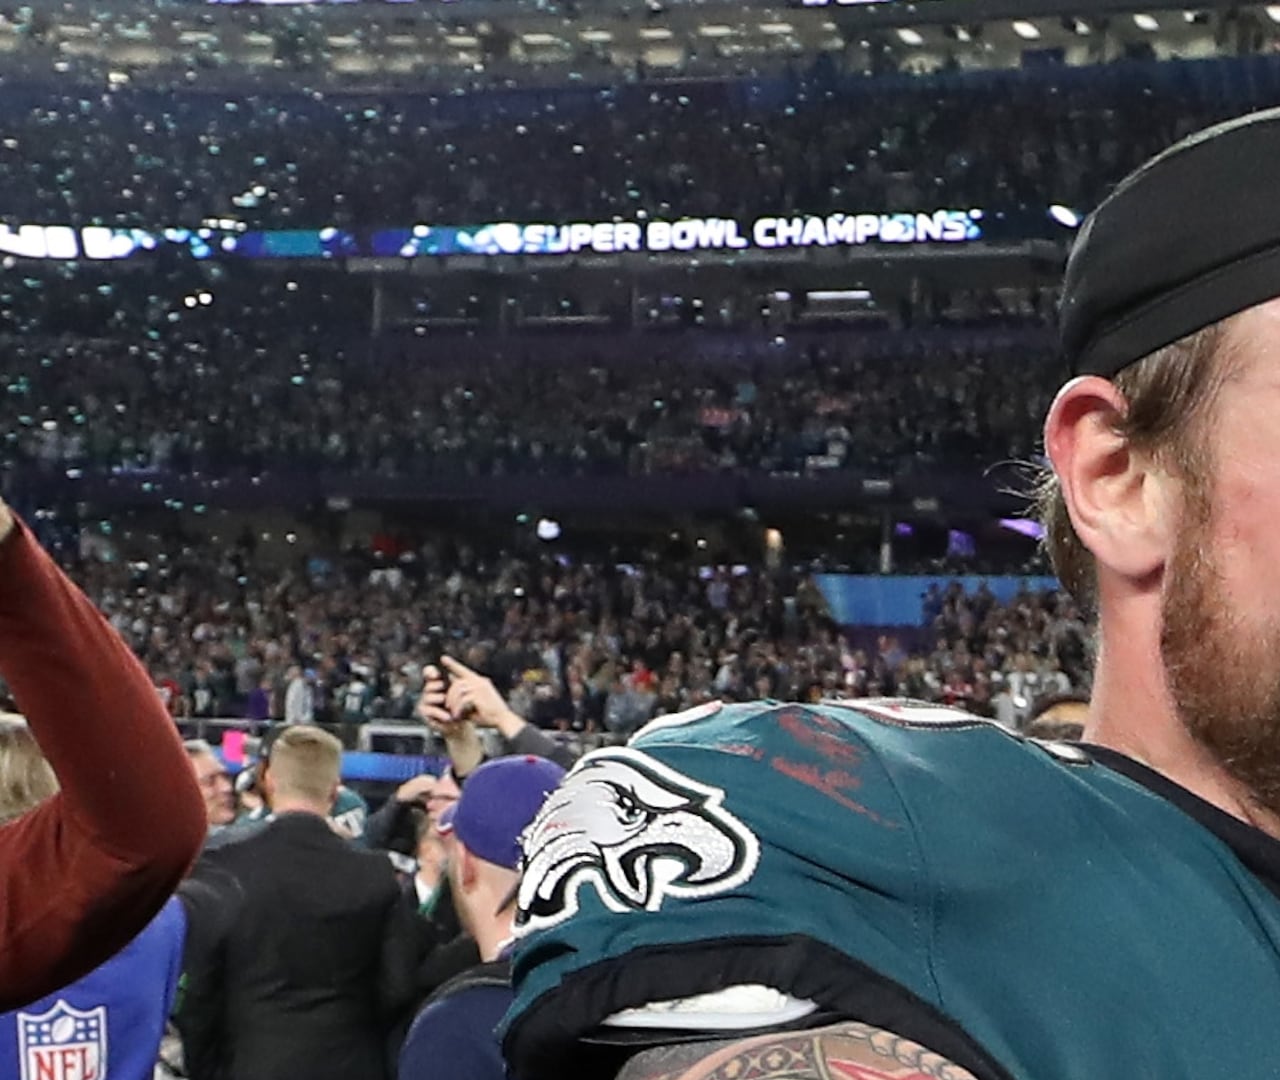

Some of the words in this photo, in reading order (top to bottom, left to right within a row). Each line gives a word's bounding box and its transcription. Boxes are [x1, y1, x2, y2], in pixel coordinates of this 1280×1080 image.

[523, 221, 642, 253] SUPER
[646, 217, 749, 250] BOWL
[753, 210, 969, 247] CHAMPIONS
